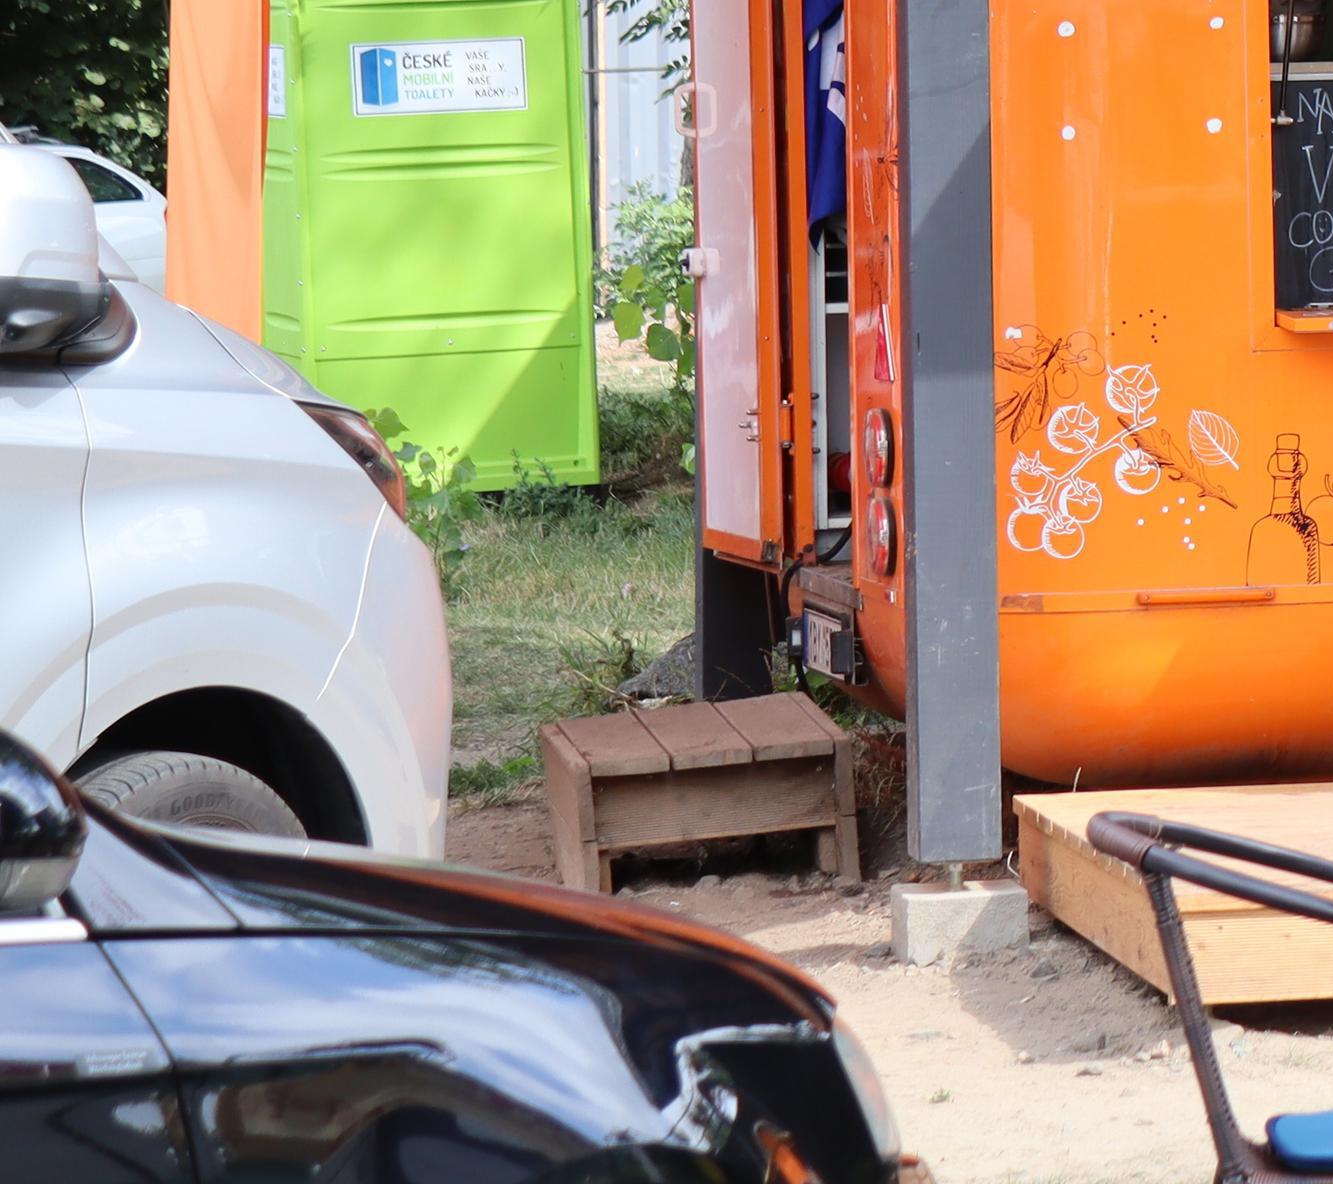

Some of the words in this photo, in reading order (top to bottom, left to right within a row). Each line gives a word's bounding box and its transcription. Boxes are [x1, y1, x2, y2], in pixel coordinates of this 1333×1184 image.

[402, 51, 453, 71] ČESKÉ
[402, 70, 455, 87] MOBILNÍ
[404, 87, 455, 101] TOALETY
